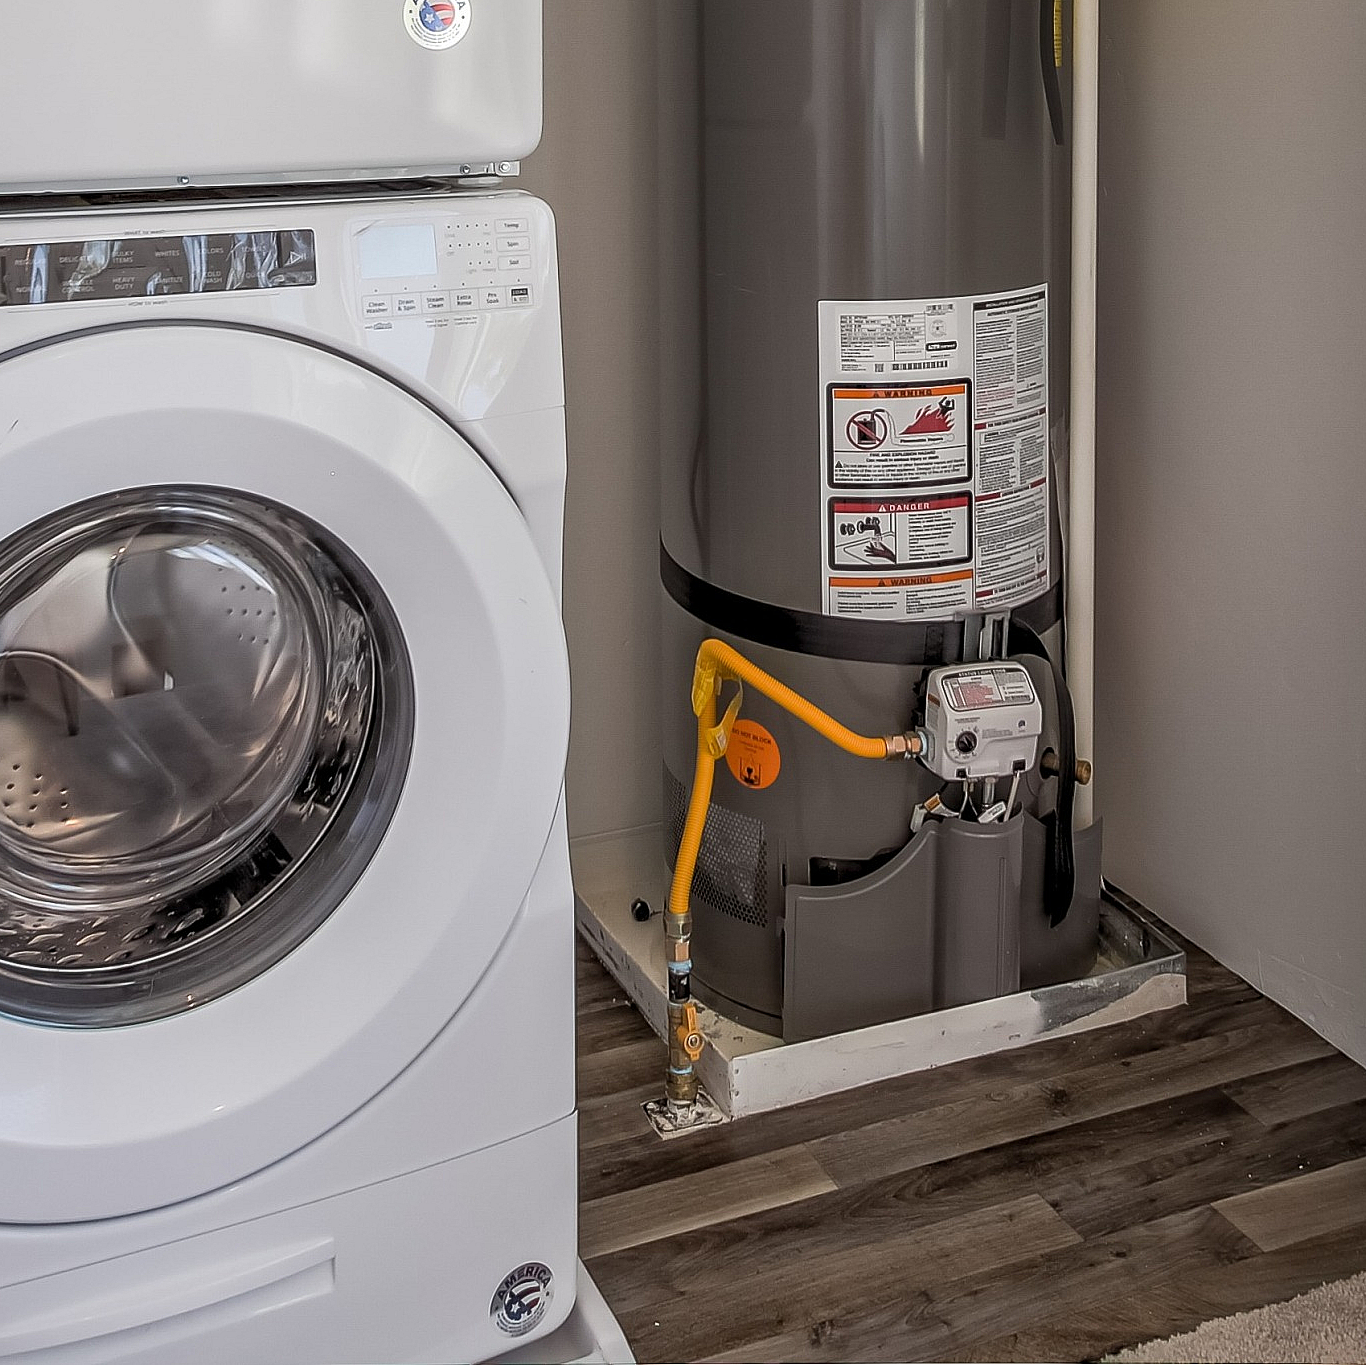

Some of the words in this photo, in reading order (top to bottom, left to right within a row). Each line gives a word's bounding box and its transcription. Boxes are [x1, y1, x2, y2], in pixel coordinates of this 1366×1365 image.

[155, 249, 180, 258] WHITES
[115, 283, 134, 291] DUTY
[884, 389, 932, 398] WARNING
[889, 502, 930, 512] DANGER
[891, 576, 932, 586] WARNING
[497, 1266, 551, 1301] AMERICA
